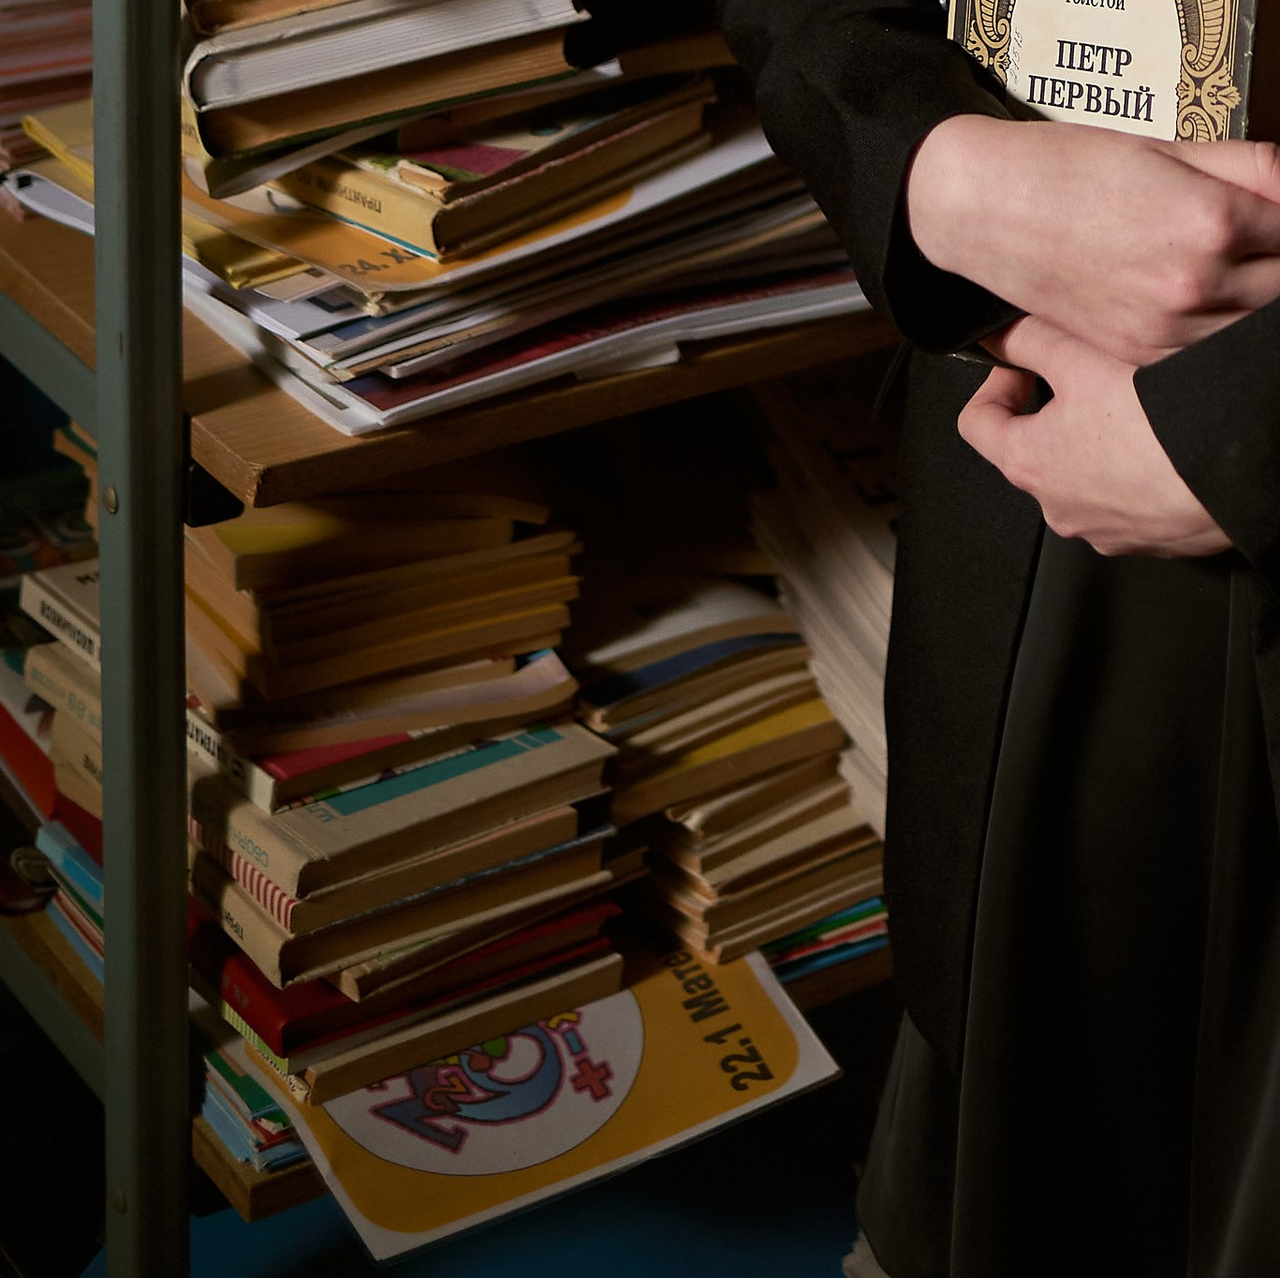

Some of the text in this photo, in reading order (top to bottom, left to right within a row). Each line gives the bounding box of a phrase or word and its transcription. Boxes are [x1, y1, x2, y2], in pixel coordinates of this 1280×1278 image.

[1055, 38, 1133, 78] ПЕТР
[1026, 74, 1156, 123] ПЕРВЫЙ
[663, 951, 775, 1094] 22.1 Мате
